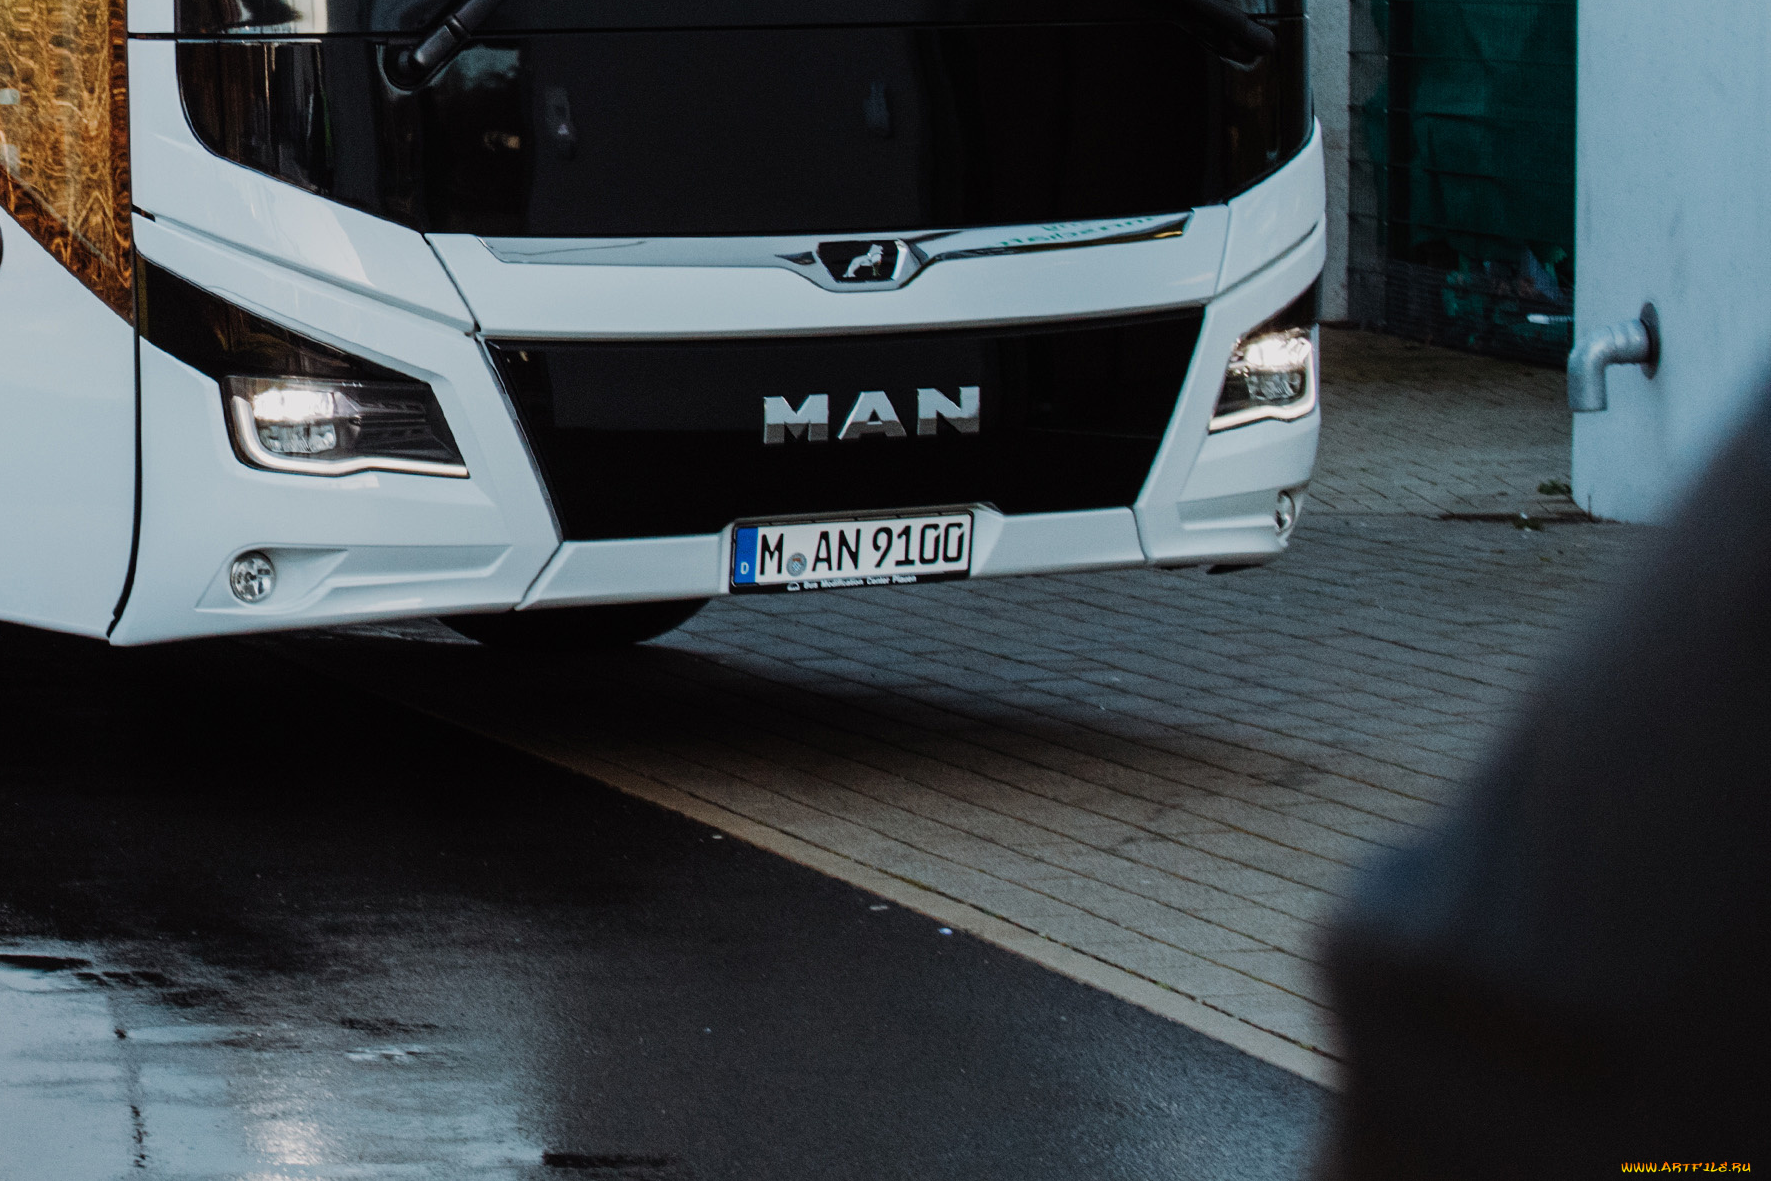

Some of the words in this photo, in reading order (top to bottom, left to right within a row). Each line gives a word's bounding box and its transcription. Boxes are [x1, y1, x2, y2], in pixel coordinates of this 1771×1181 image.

[762, 385, 981, 445] MAN
[759, 533, 784, 576] M
[811, 528, 861, 572] AN
[872, 522, 964, 569] 9100
